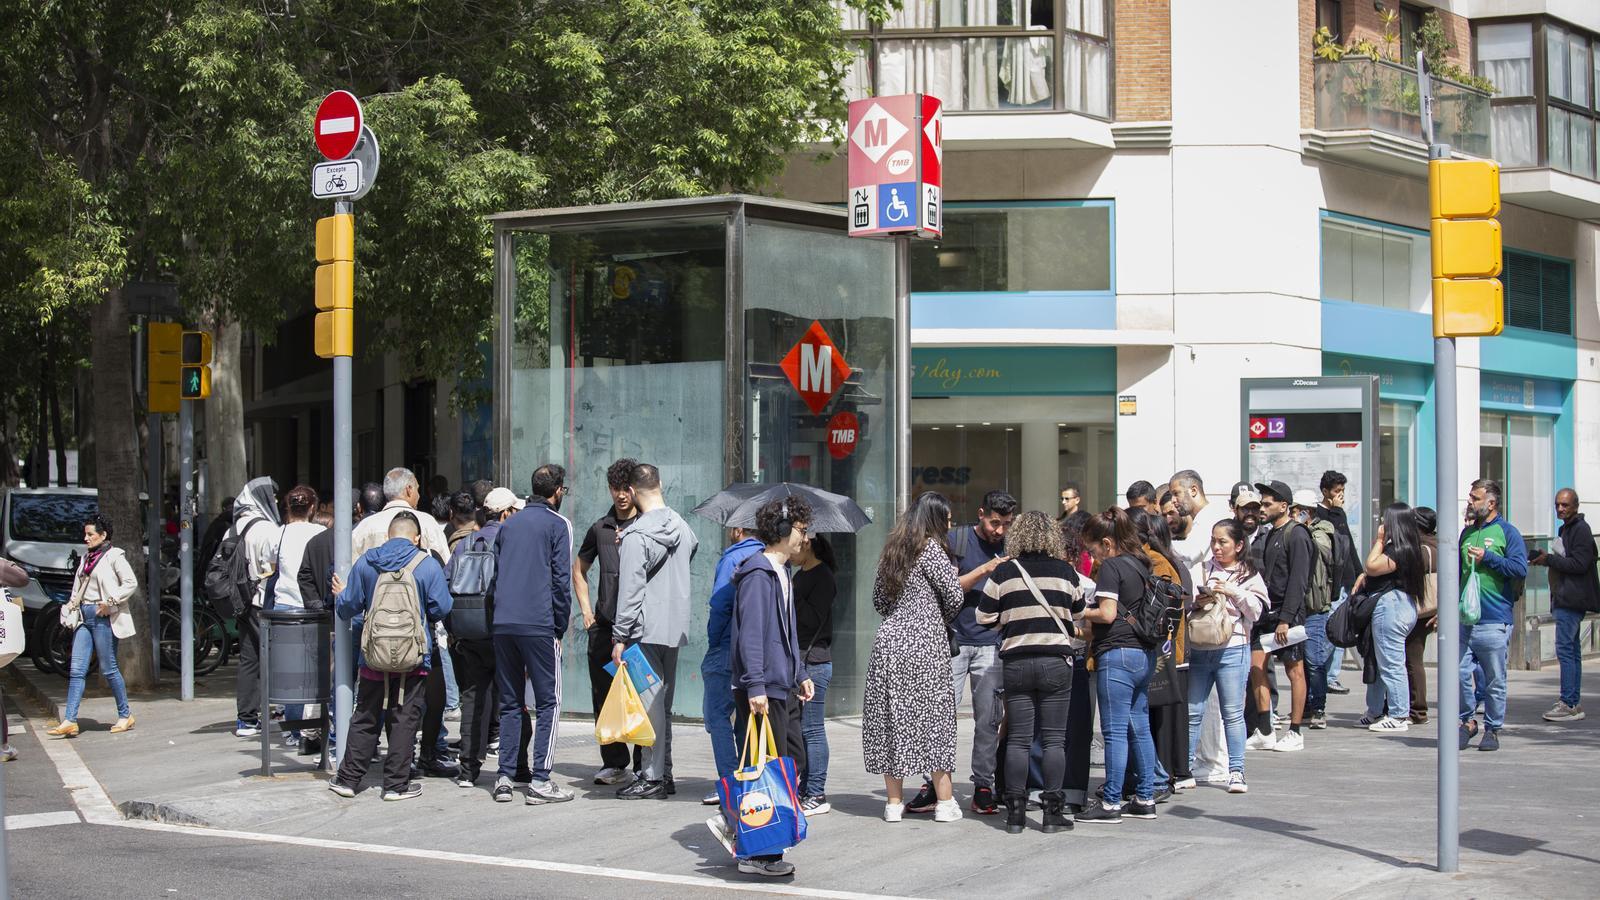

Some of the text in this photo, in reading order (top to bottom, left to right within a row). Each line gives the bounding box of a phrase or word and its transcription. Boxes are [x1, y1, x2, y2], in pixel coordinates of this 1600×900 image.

[864, 118, 888, 148] M
[326, 166, 347, 174] Excepte
[891, 159, 910, 168] TMB
[800, 342, 833, 394] M
[1268, 421, 1284, 434] L2
[831, 429, 855, 444] TMB
